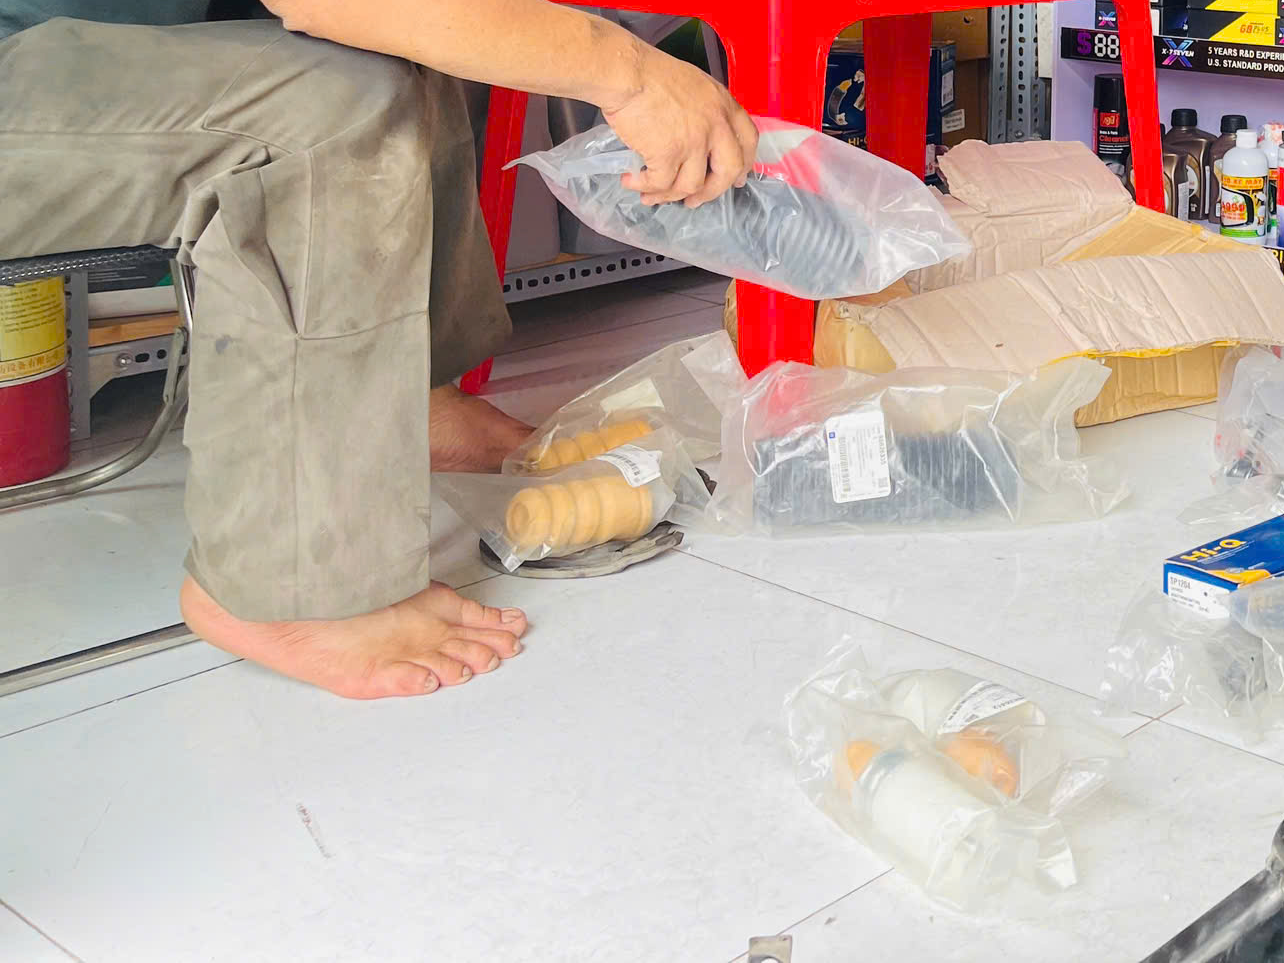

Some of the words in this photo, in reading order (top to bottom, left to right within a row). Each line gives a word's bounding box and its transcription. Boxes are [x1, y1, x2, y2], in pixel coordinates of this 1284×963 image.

[1207, 46, 1213, 55] 5
[1213, 47, 1238, 57] YEARS
[1239, 49, 1255, 59] R&D
[1207, 58, 1221, 67] U.S.
[1222, 59, 1262, 71] STANDARD
[1180, 538, 1249, 562] Hi-Q
